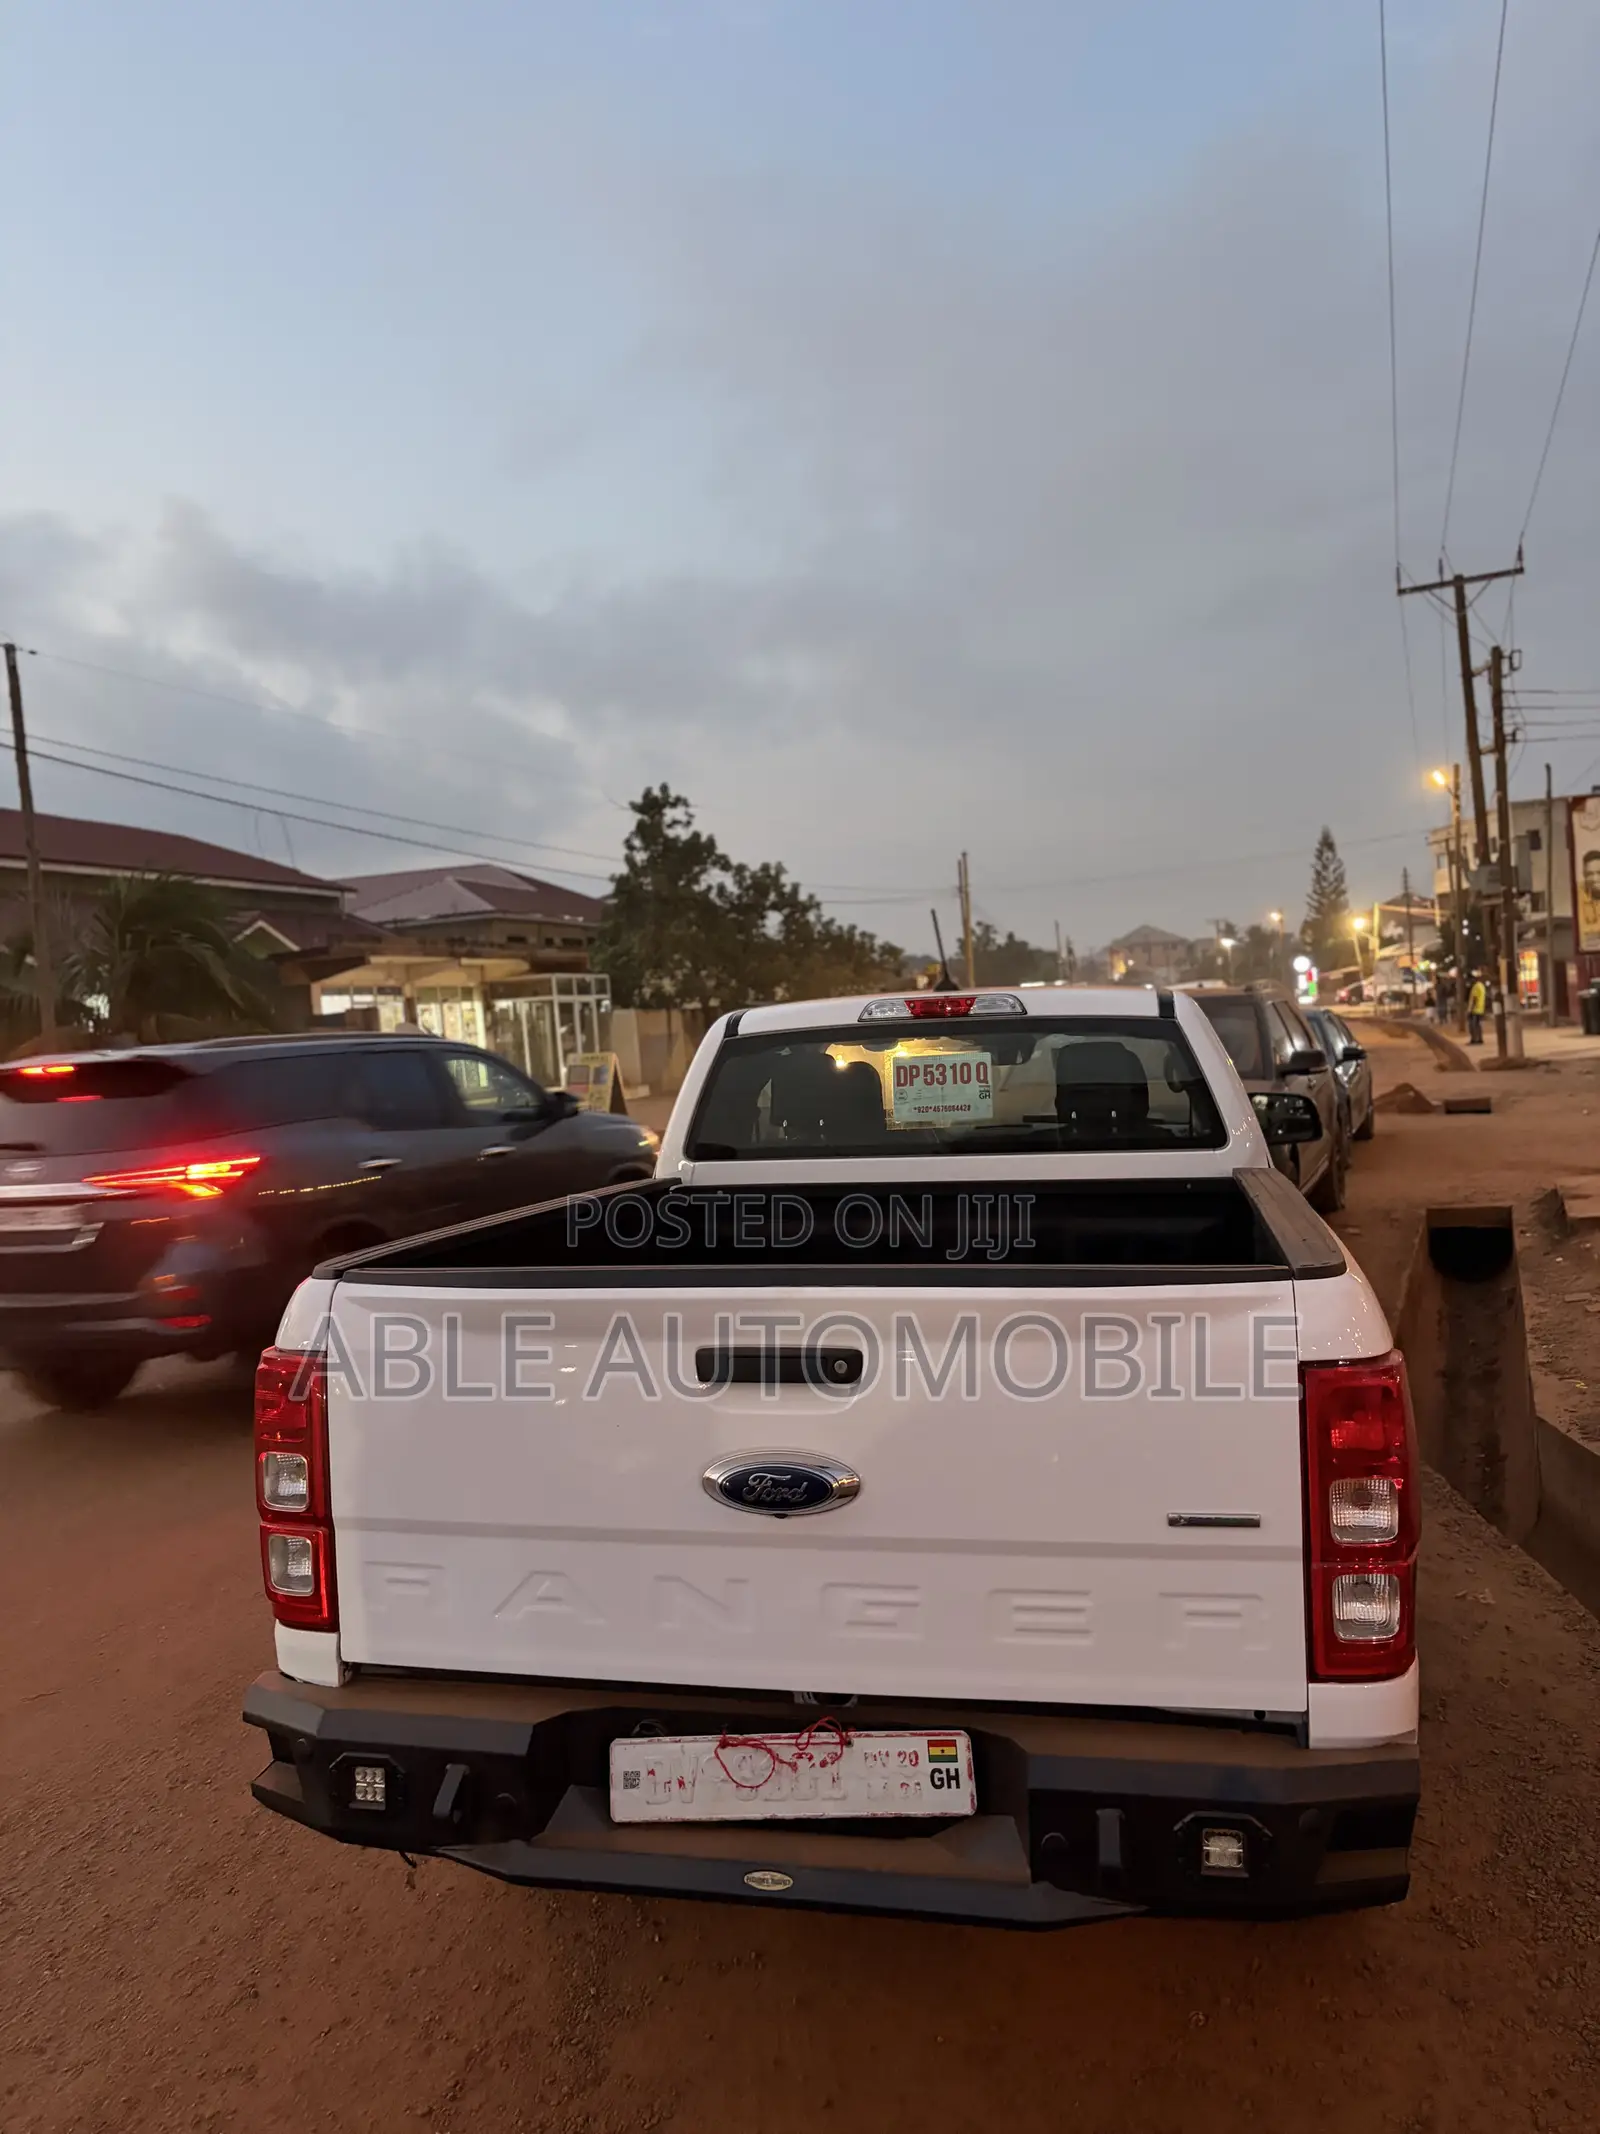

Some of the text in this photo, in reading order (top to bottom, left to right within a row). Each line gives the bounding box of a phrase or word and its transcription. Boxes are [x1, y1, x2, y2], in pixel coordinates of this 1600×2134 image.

[743, 1472, 808, 1502] Ford
[363, 1560, 1275, 1648] RANGER
[929, 1767, 961, 1791] GH
